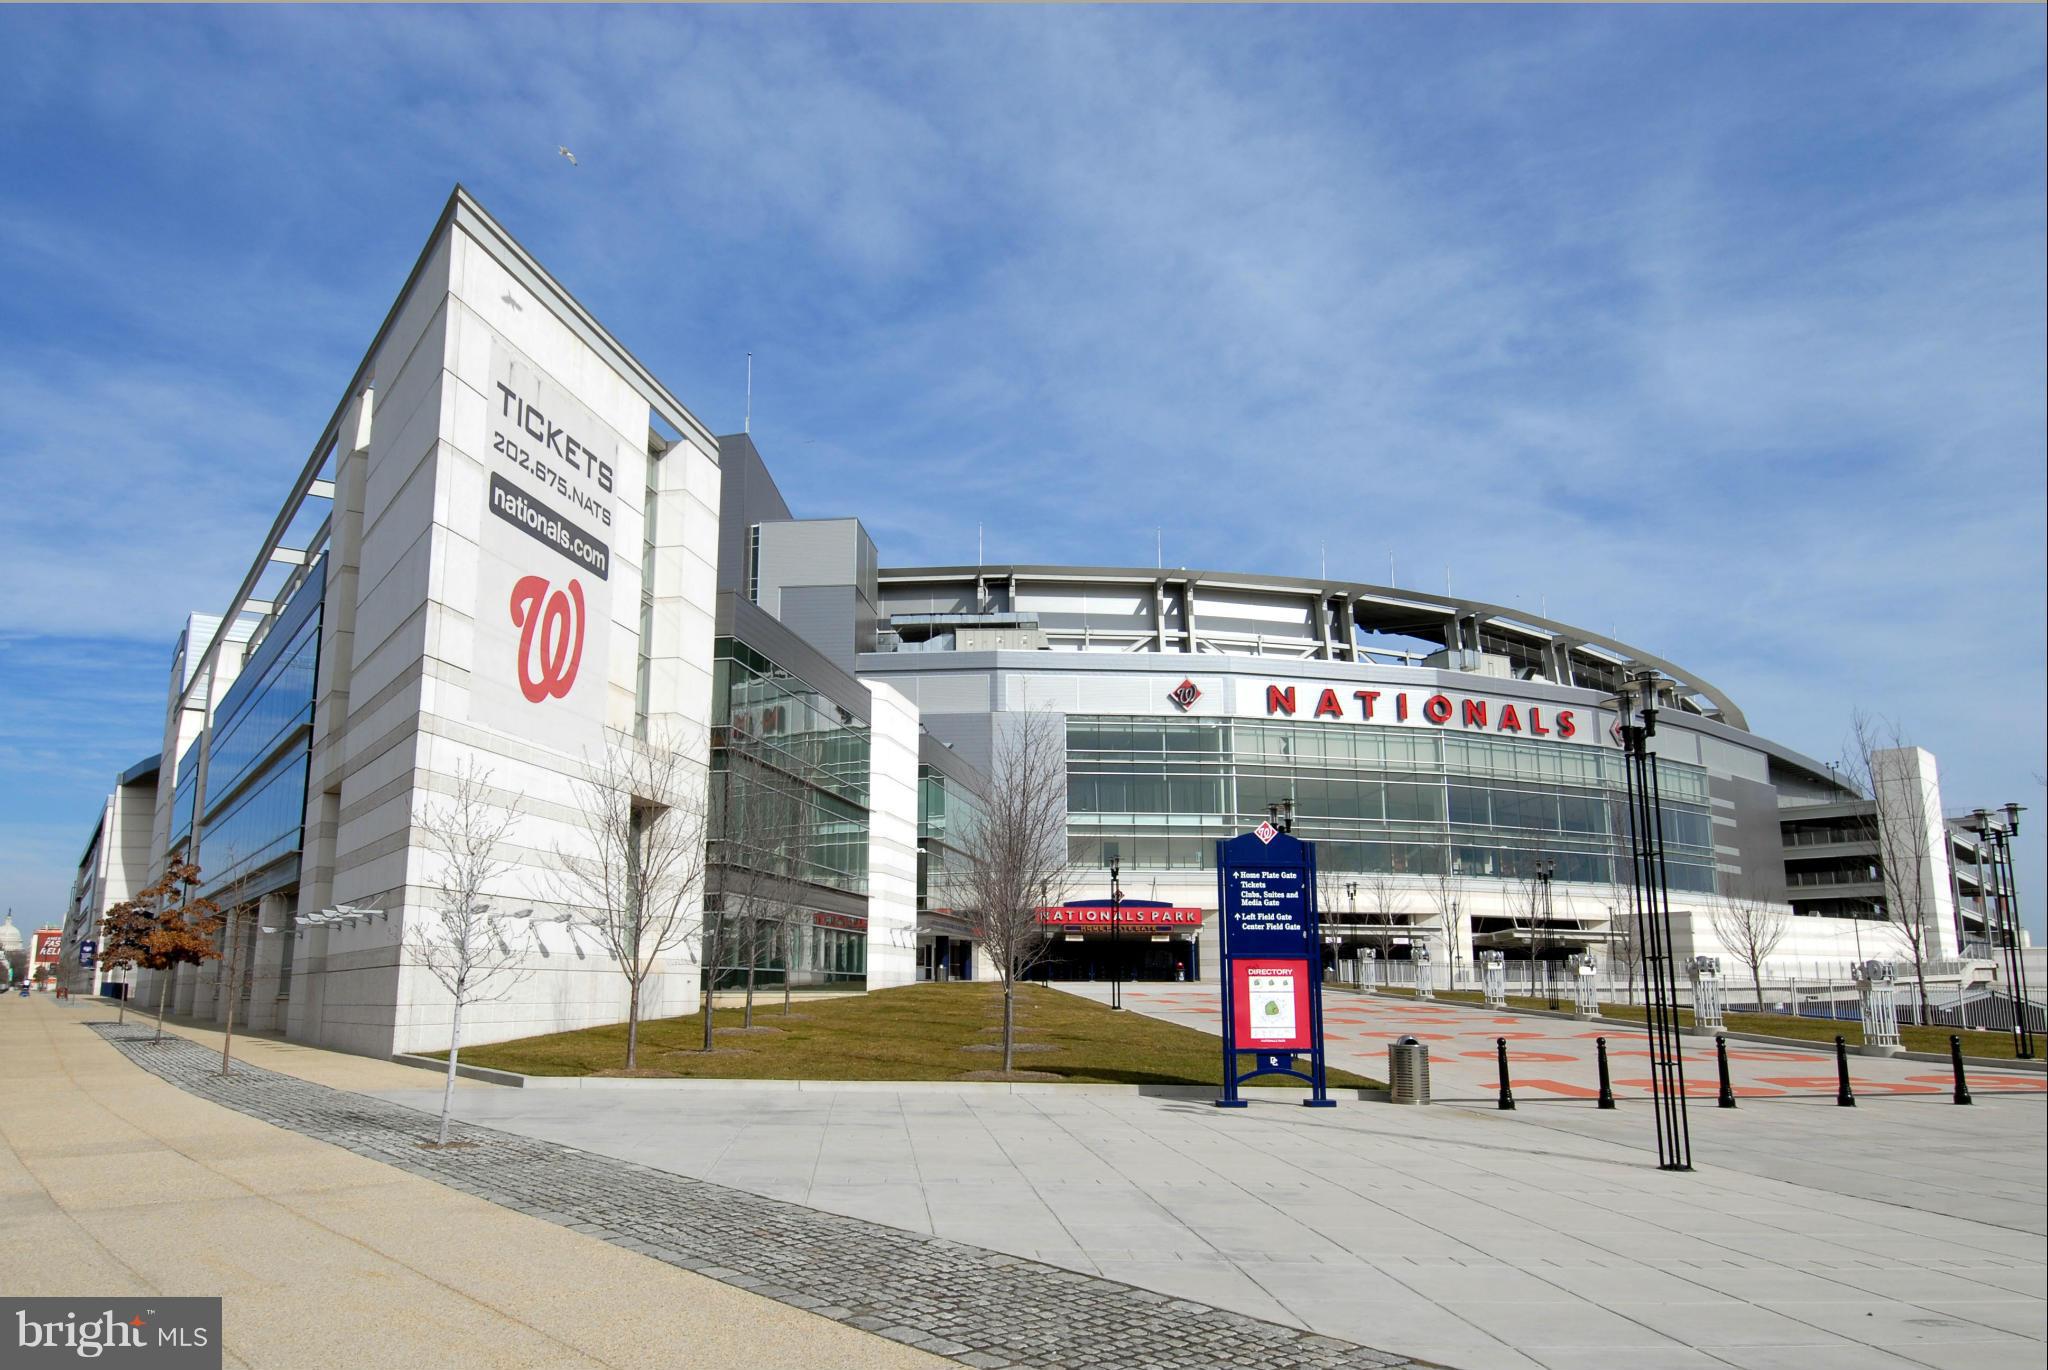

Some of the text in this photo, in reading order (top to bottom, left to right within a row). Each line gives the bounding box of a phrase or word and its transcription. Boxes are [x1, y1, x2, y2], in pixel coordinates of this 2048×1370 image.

[497, 380, 613, 493] TICKETS
[493, 431, 611, 527] 202.675.NATS
[494, 486, 606, 571] nationals.com
[510, 575, 585, 703] W
[1266, 684, 1576, 738] NATIONALS
[1240, 871, 1297, 879] Home Plate Gate
[1040, 910, 1195, 921] NATIONALS PARK
[1242, 912, 1293, 920] Left Field Gate
[1242, 922, 1301, 930] Center Field Gate
[1248, 968, 1293, 976] DIRECTORY
